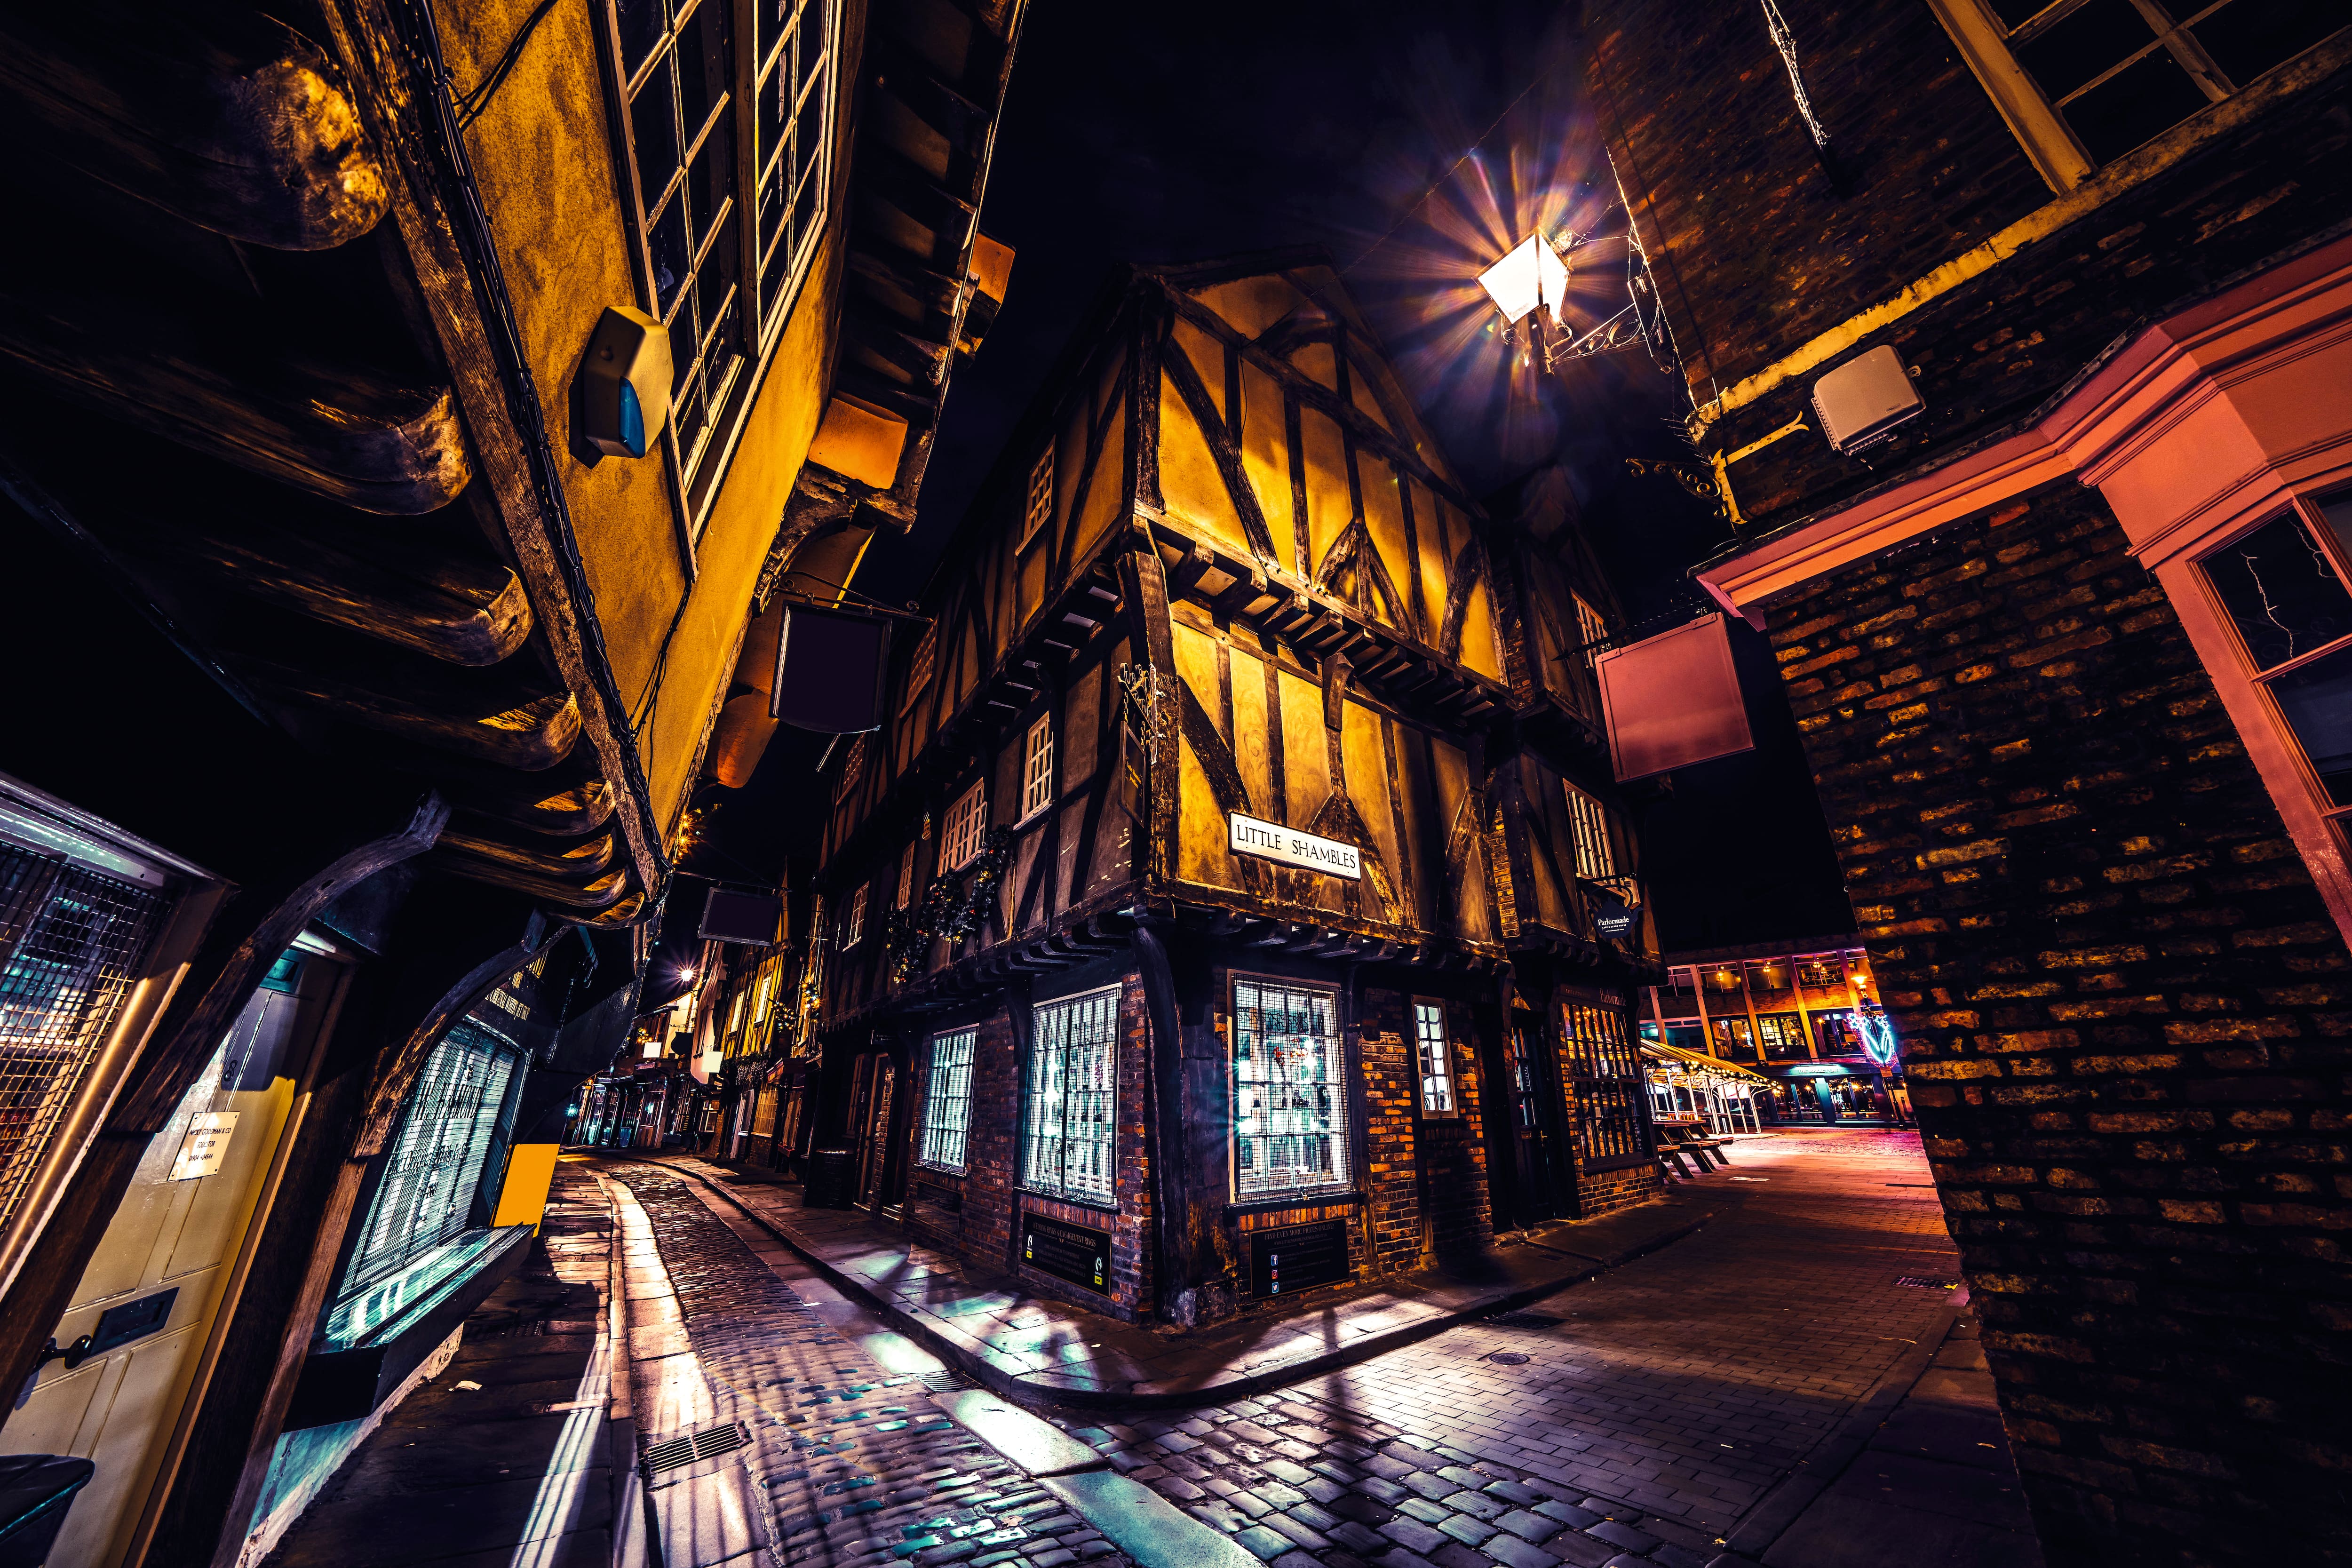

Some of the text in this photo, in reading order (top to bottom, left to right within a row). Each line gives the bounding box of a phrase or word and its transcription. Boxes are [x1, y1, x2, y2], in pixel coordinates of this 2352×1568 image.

[1237, 824, 1356, 869] LITTLE SHAMBLES
[1597, 915, 1629, 926] Parlormade
[1060, 1230, 1084, 1243] ENGAGEMENT
[1084, 1237, 1096, 1247] RINGS
[1290, 1228, 1303, 1237] MORE
[1303, 1226, 1318, 1235] PIECES
